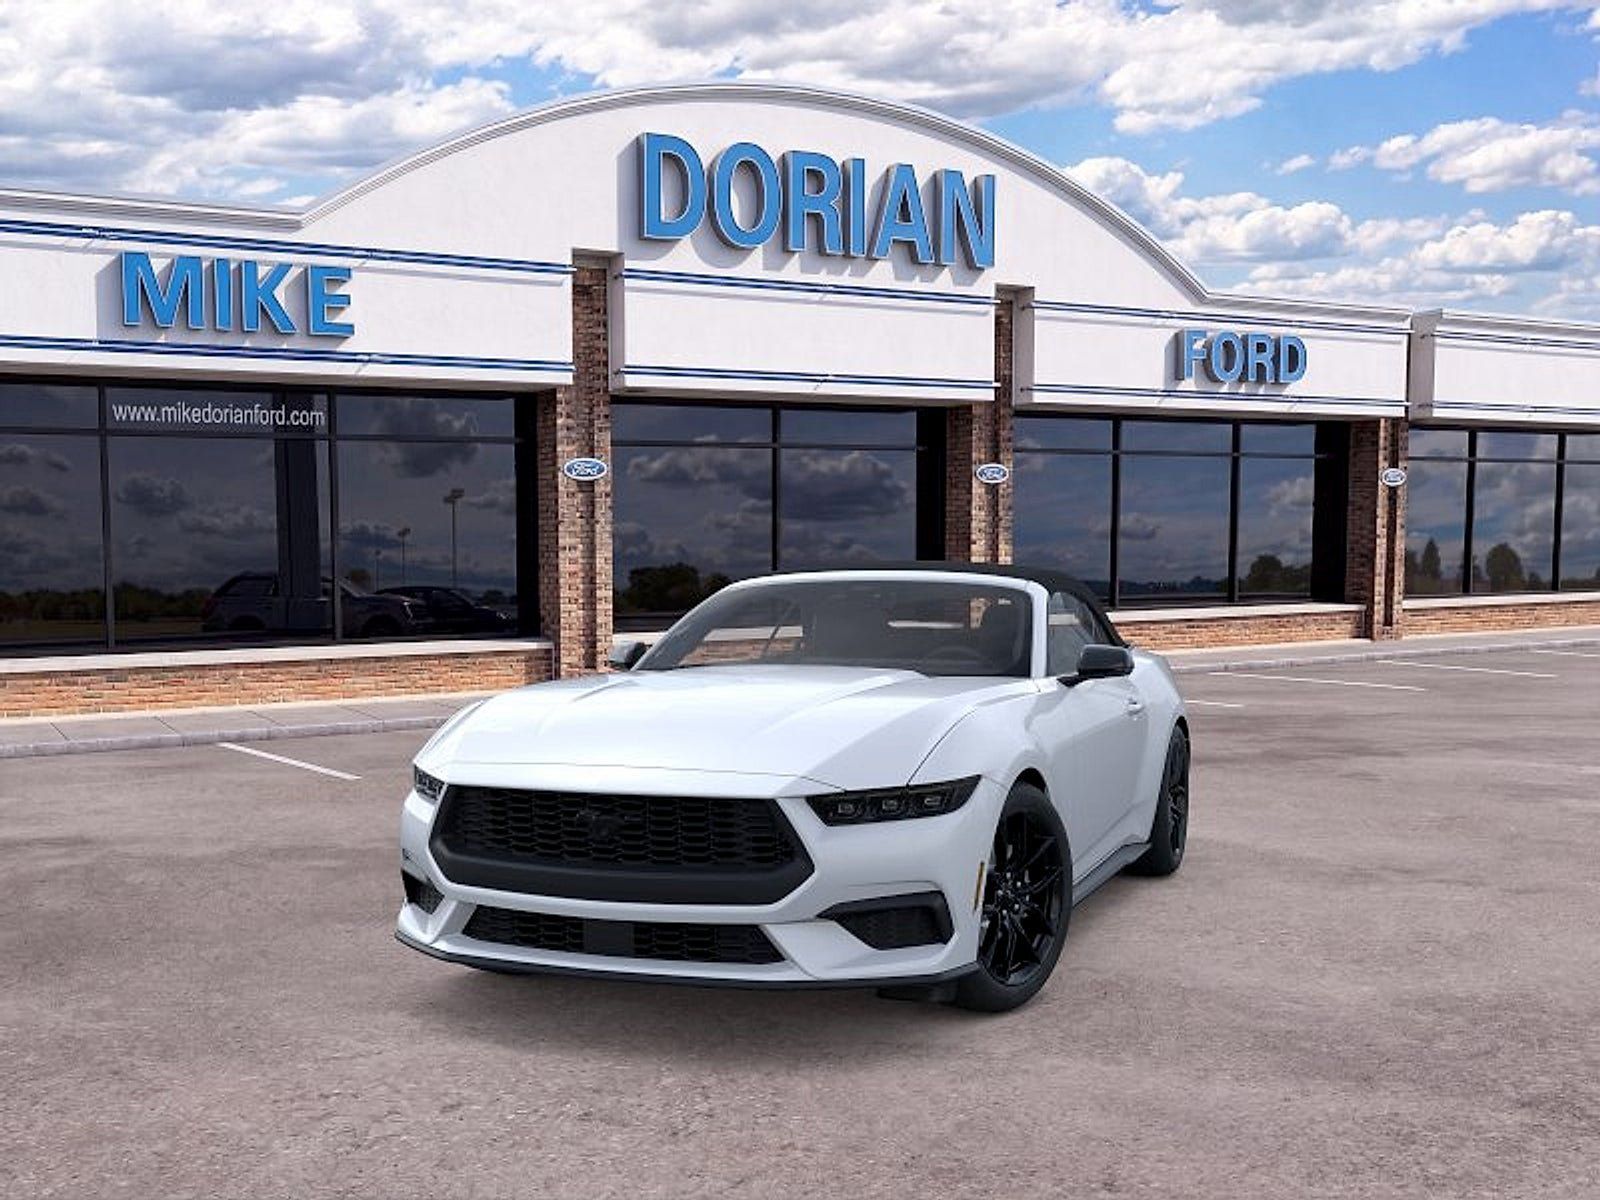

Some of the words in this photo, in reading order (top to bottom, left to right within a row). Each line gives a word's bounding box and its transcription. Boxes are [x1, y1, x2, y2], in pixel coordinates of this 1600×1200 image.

[639, 131, 995, 269] DORIAN
[121, 251, 354, 338] MIKE
[1175, 329, 1307, 384] FORD
[112, 402, 325, 426] www.mikedorianford.com
